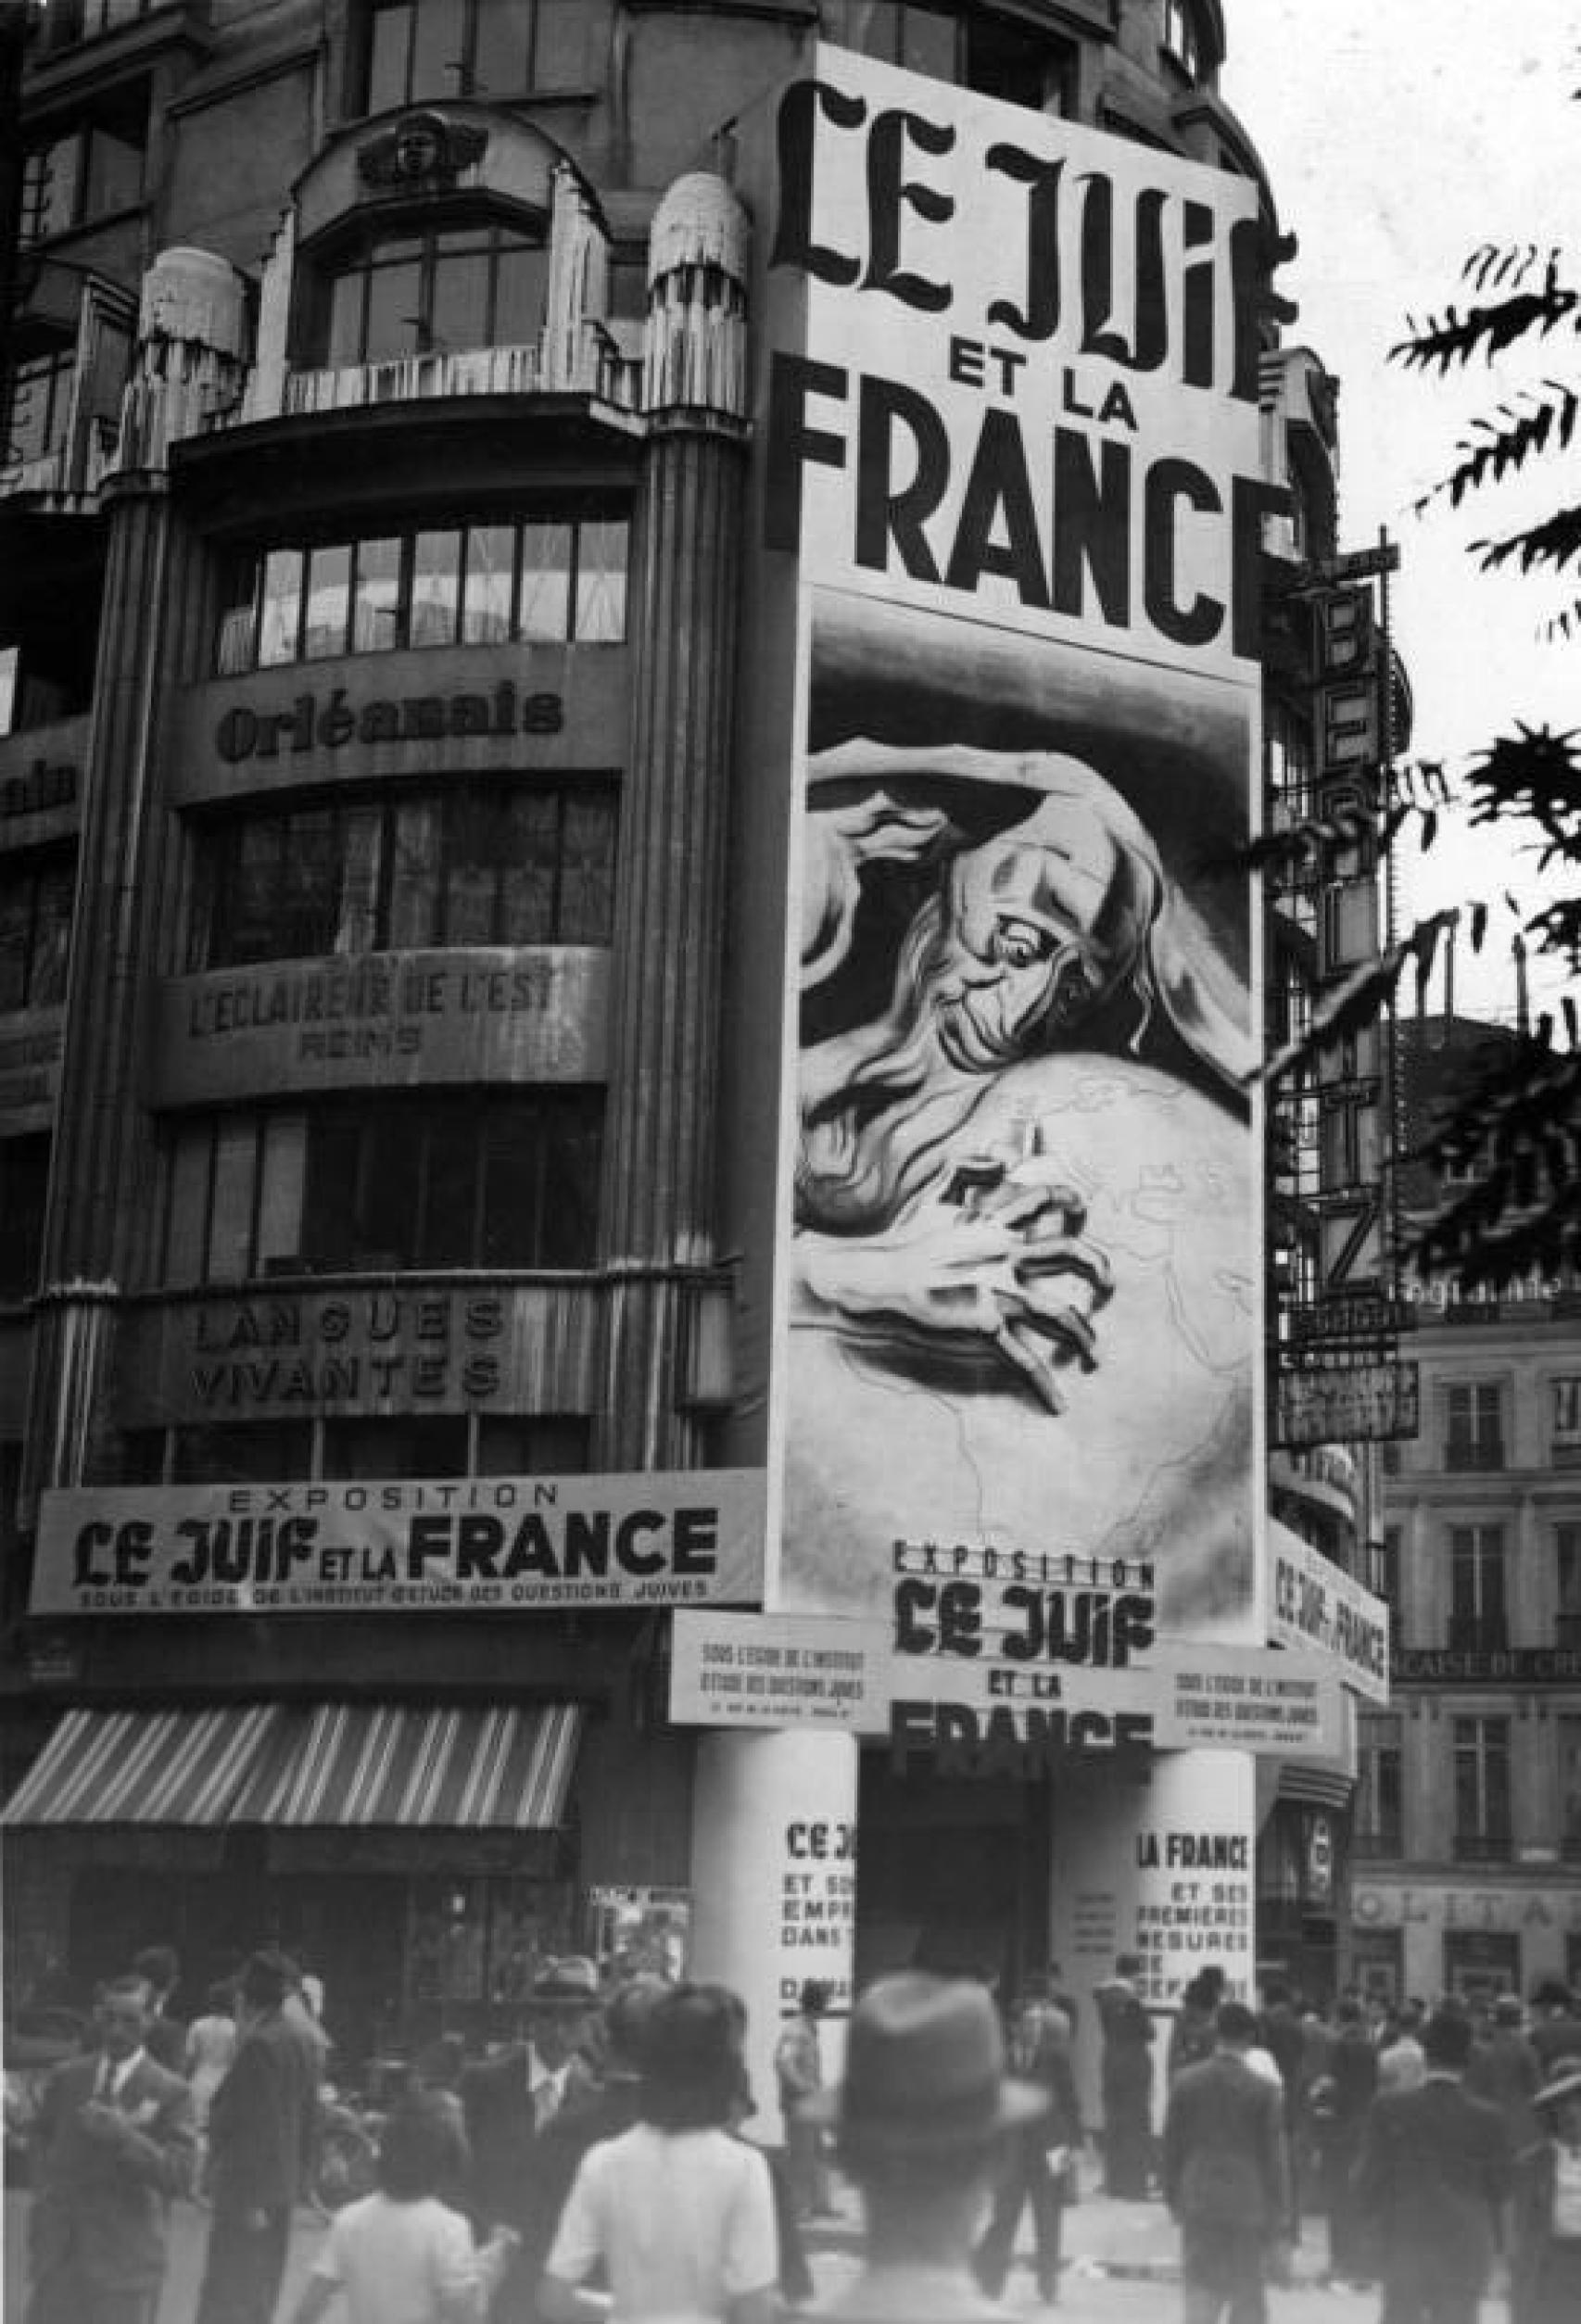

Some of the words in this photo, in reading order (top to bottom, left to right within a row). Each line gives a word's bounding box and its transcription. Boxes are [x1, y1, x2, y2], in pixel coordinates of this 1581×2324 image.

[985, 143, 1299, 403] JUIF
[950, 336, 1027, 397] ET
[1062, 368, 1139, 432] LA
[765, 351, 1296, 662] FRANCE
[216, 679, 564, 764] Orléanais
[407, 973, 446, 1015] DE
[194, 1298, 505, 1354] LANGUES
[190, 1356, 501, 1407] VIVANTES
[230, 1484, 559, 1513] EXPOSITION
[170, 1517, 320, 1584] JUIF
[320, 1548, 356, 1581] ET
[361, 1547, 396, 1581] LA
[408, 1509, 719, 1581] FRANCE
[892, 1539, 1156, 1592] EXPOSITION
[636, 1578, 709, 1600] JUIVES
[1001, 1585, 1157, 1670] JUIF
[988, 1668, 1017, 1696] ET
[1031, 1672, 1062, 1699] LA
[890, 1701, 1155, 1772] FRANCE
[1136, 1833, 1158, 1869] LA
[1166, 1833, 1247, 1870] FRANCE
[781, 1873, 814, 1895] ET
[1171, 1882, 1201, 1904] ET
[781, 1926, 840, 1948] DANS
